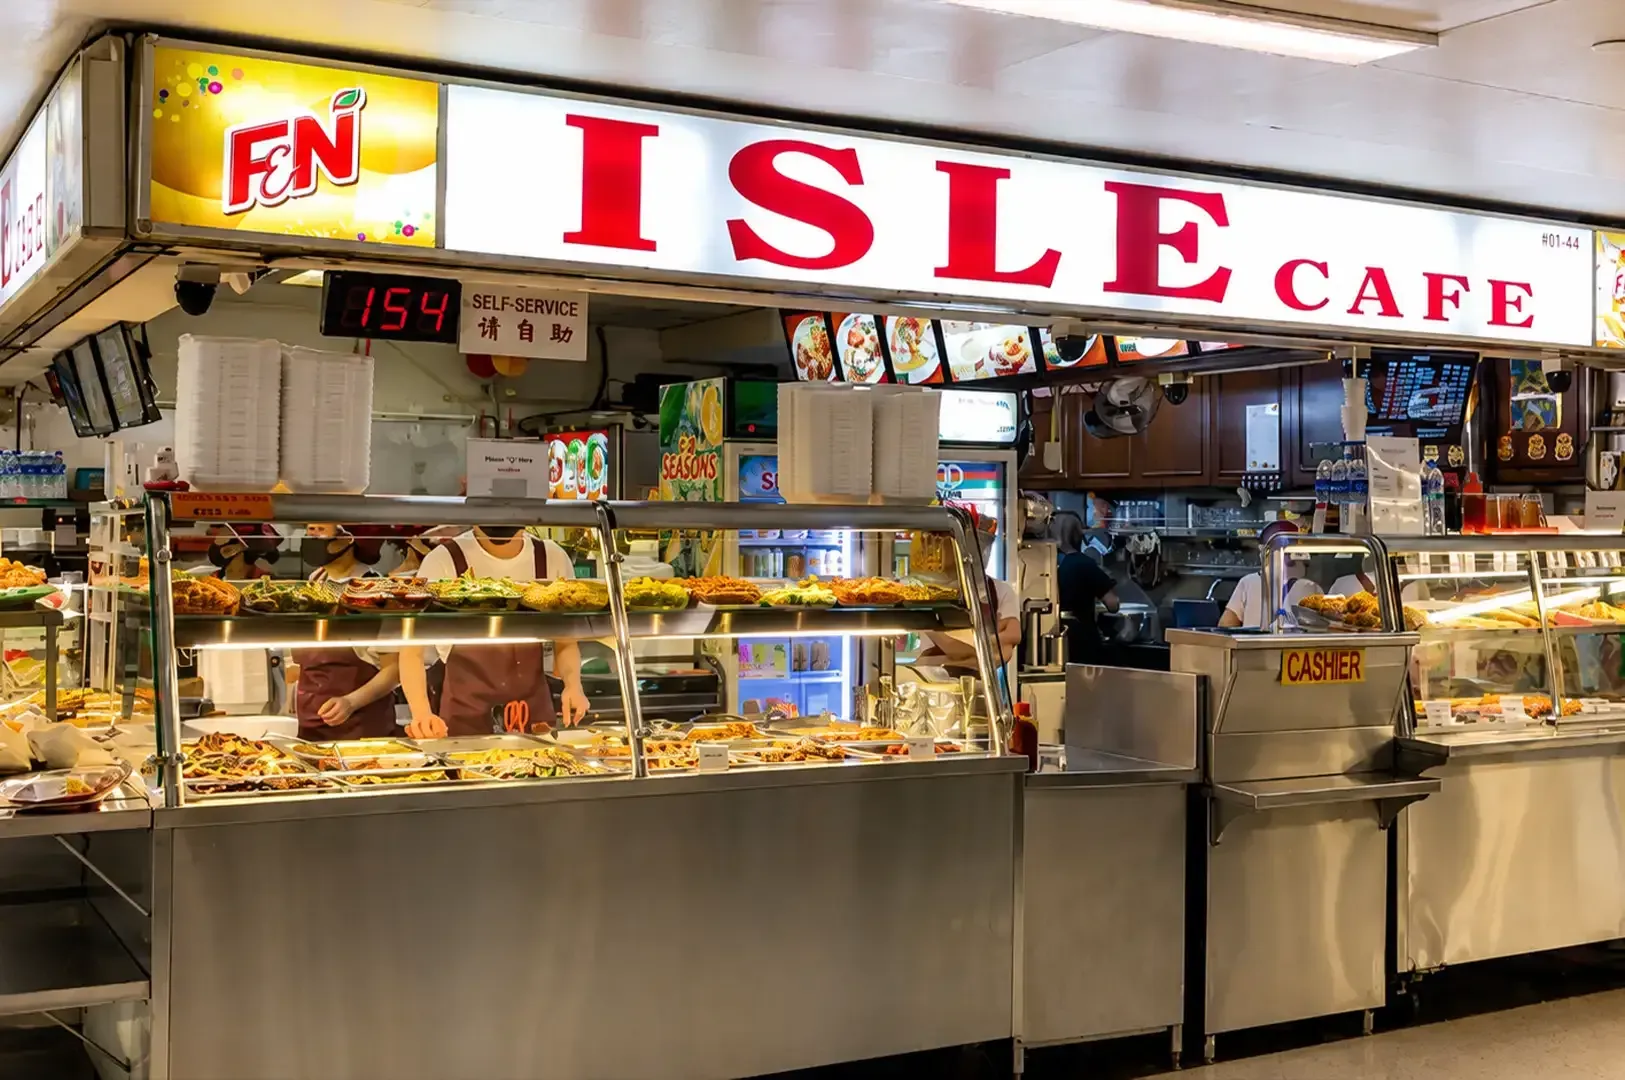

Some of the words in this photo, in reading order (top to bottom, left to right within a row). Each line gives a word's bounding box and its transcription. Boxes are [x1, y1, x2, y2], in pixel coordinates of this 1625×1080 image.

[225, 95, 362, 211] F&N
[563, 113, 1232, 303] ISLE
[1274, 258, 1534, 329] CAFE
[1541, 232, 1579, 250] #01-44
[360, 287, 449, 331] 154
[472, 293, 578, 318] SELF-SERVICE
[662, 452, 717, 480] SEASONS
[1287, 650, 1361, 682] CASHIER
